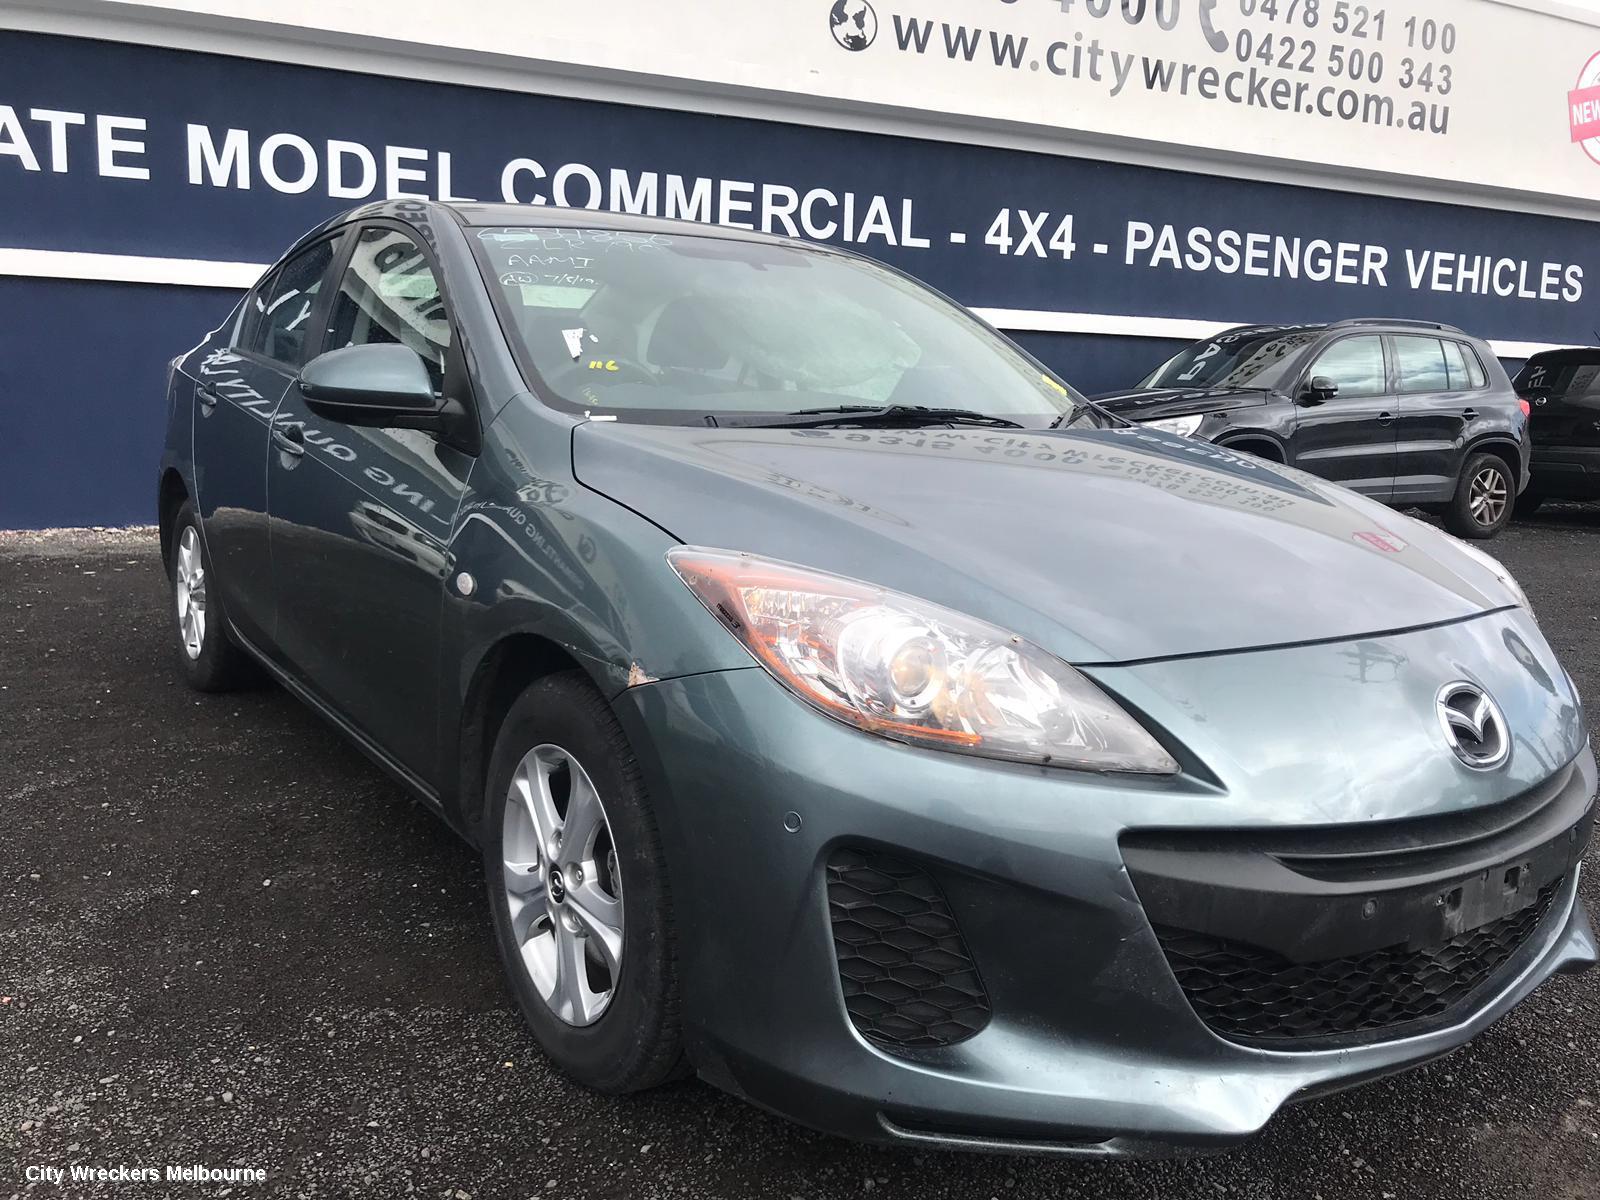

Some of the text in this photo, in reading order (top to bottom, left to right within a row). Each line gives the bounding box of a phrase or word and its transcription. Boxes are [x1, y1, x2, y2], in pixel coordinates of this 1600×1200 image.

[1333, 1, 1386, 41] 521
[1405, 16, 1456, 51] 100
[892, 15, 1451, 134] www.citywrecker.com.au
[1236, 28, 1452, 95] 0422 500 343
[187, 124, 477, 202] MODEL
[501, 158, 930, 249] COMMERCIAL
[985, 208, 1076, 259] 4X4
[1126, 221, 1388, 287] PASSENGER
[1406, 249, 1584, 303] VEHICLES
[508, 254, 594, 269] AAMI
